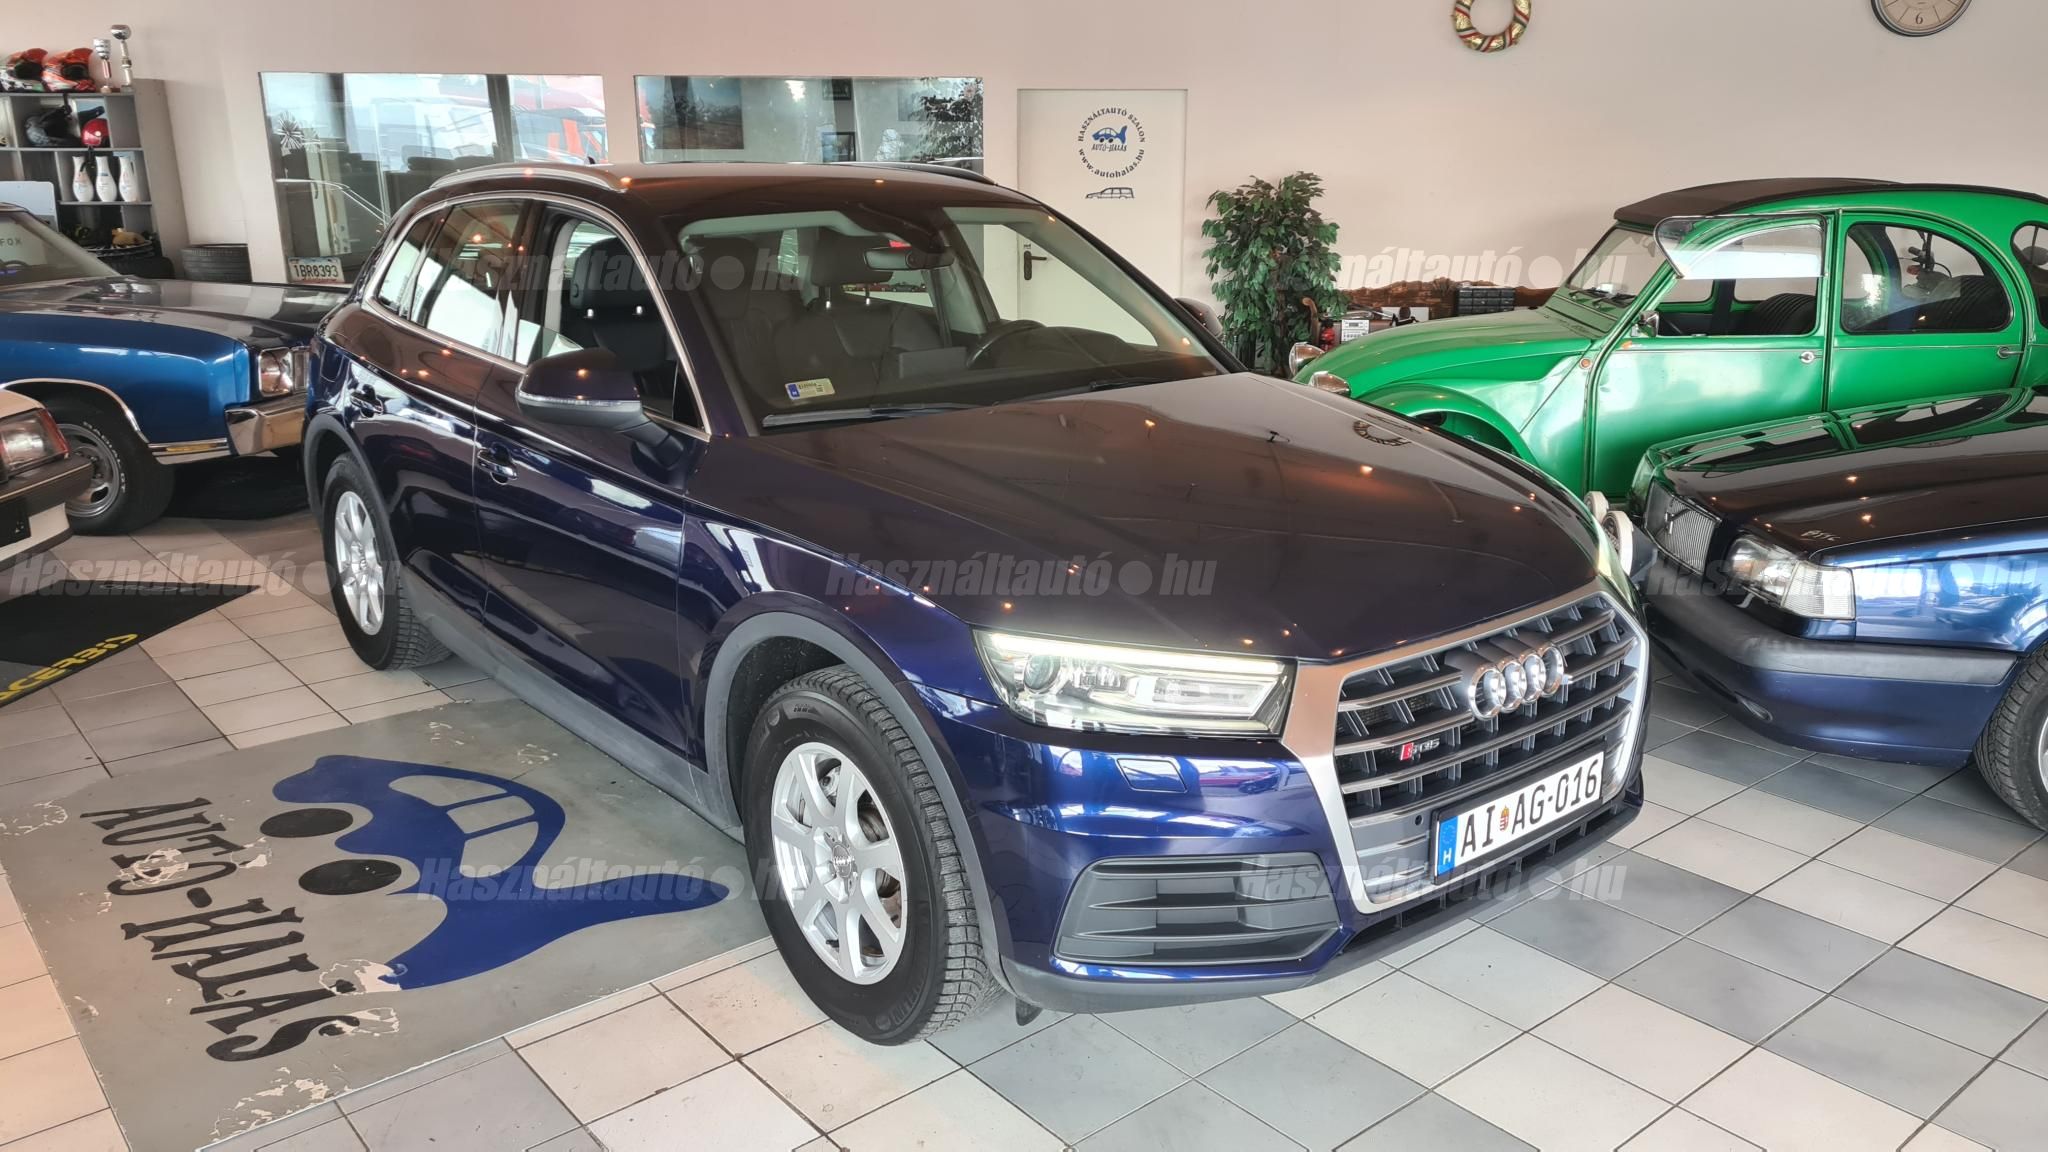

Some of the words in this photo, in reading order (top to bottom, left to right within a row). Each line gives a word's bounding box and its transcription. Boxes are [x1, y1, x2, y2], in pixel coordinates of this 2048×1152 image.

[1915, 13, 1924, 25] 6
[1078, 107, 1128, 142] HASZNÁLTAUTÓ
[1128, 113, 1146, 143] SZALON
[1078, 148, 1145, 178] www.autohalas.hu
[294, 265, 338, 277] 1BR8393
[1443, 848, 1453, 865] H
[1461, 805, 1496, 857] AI
[1512, 759, 1599, 835] AG-016
